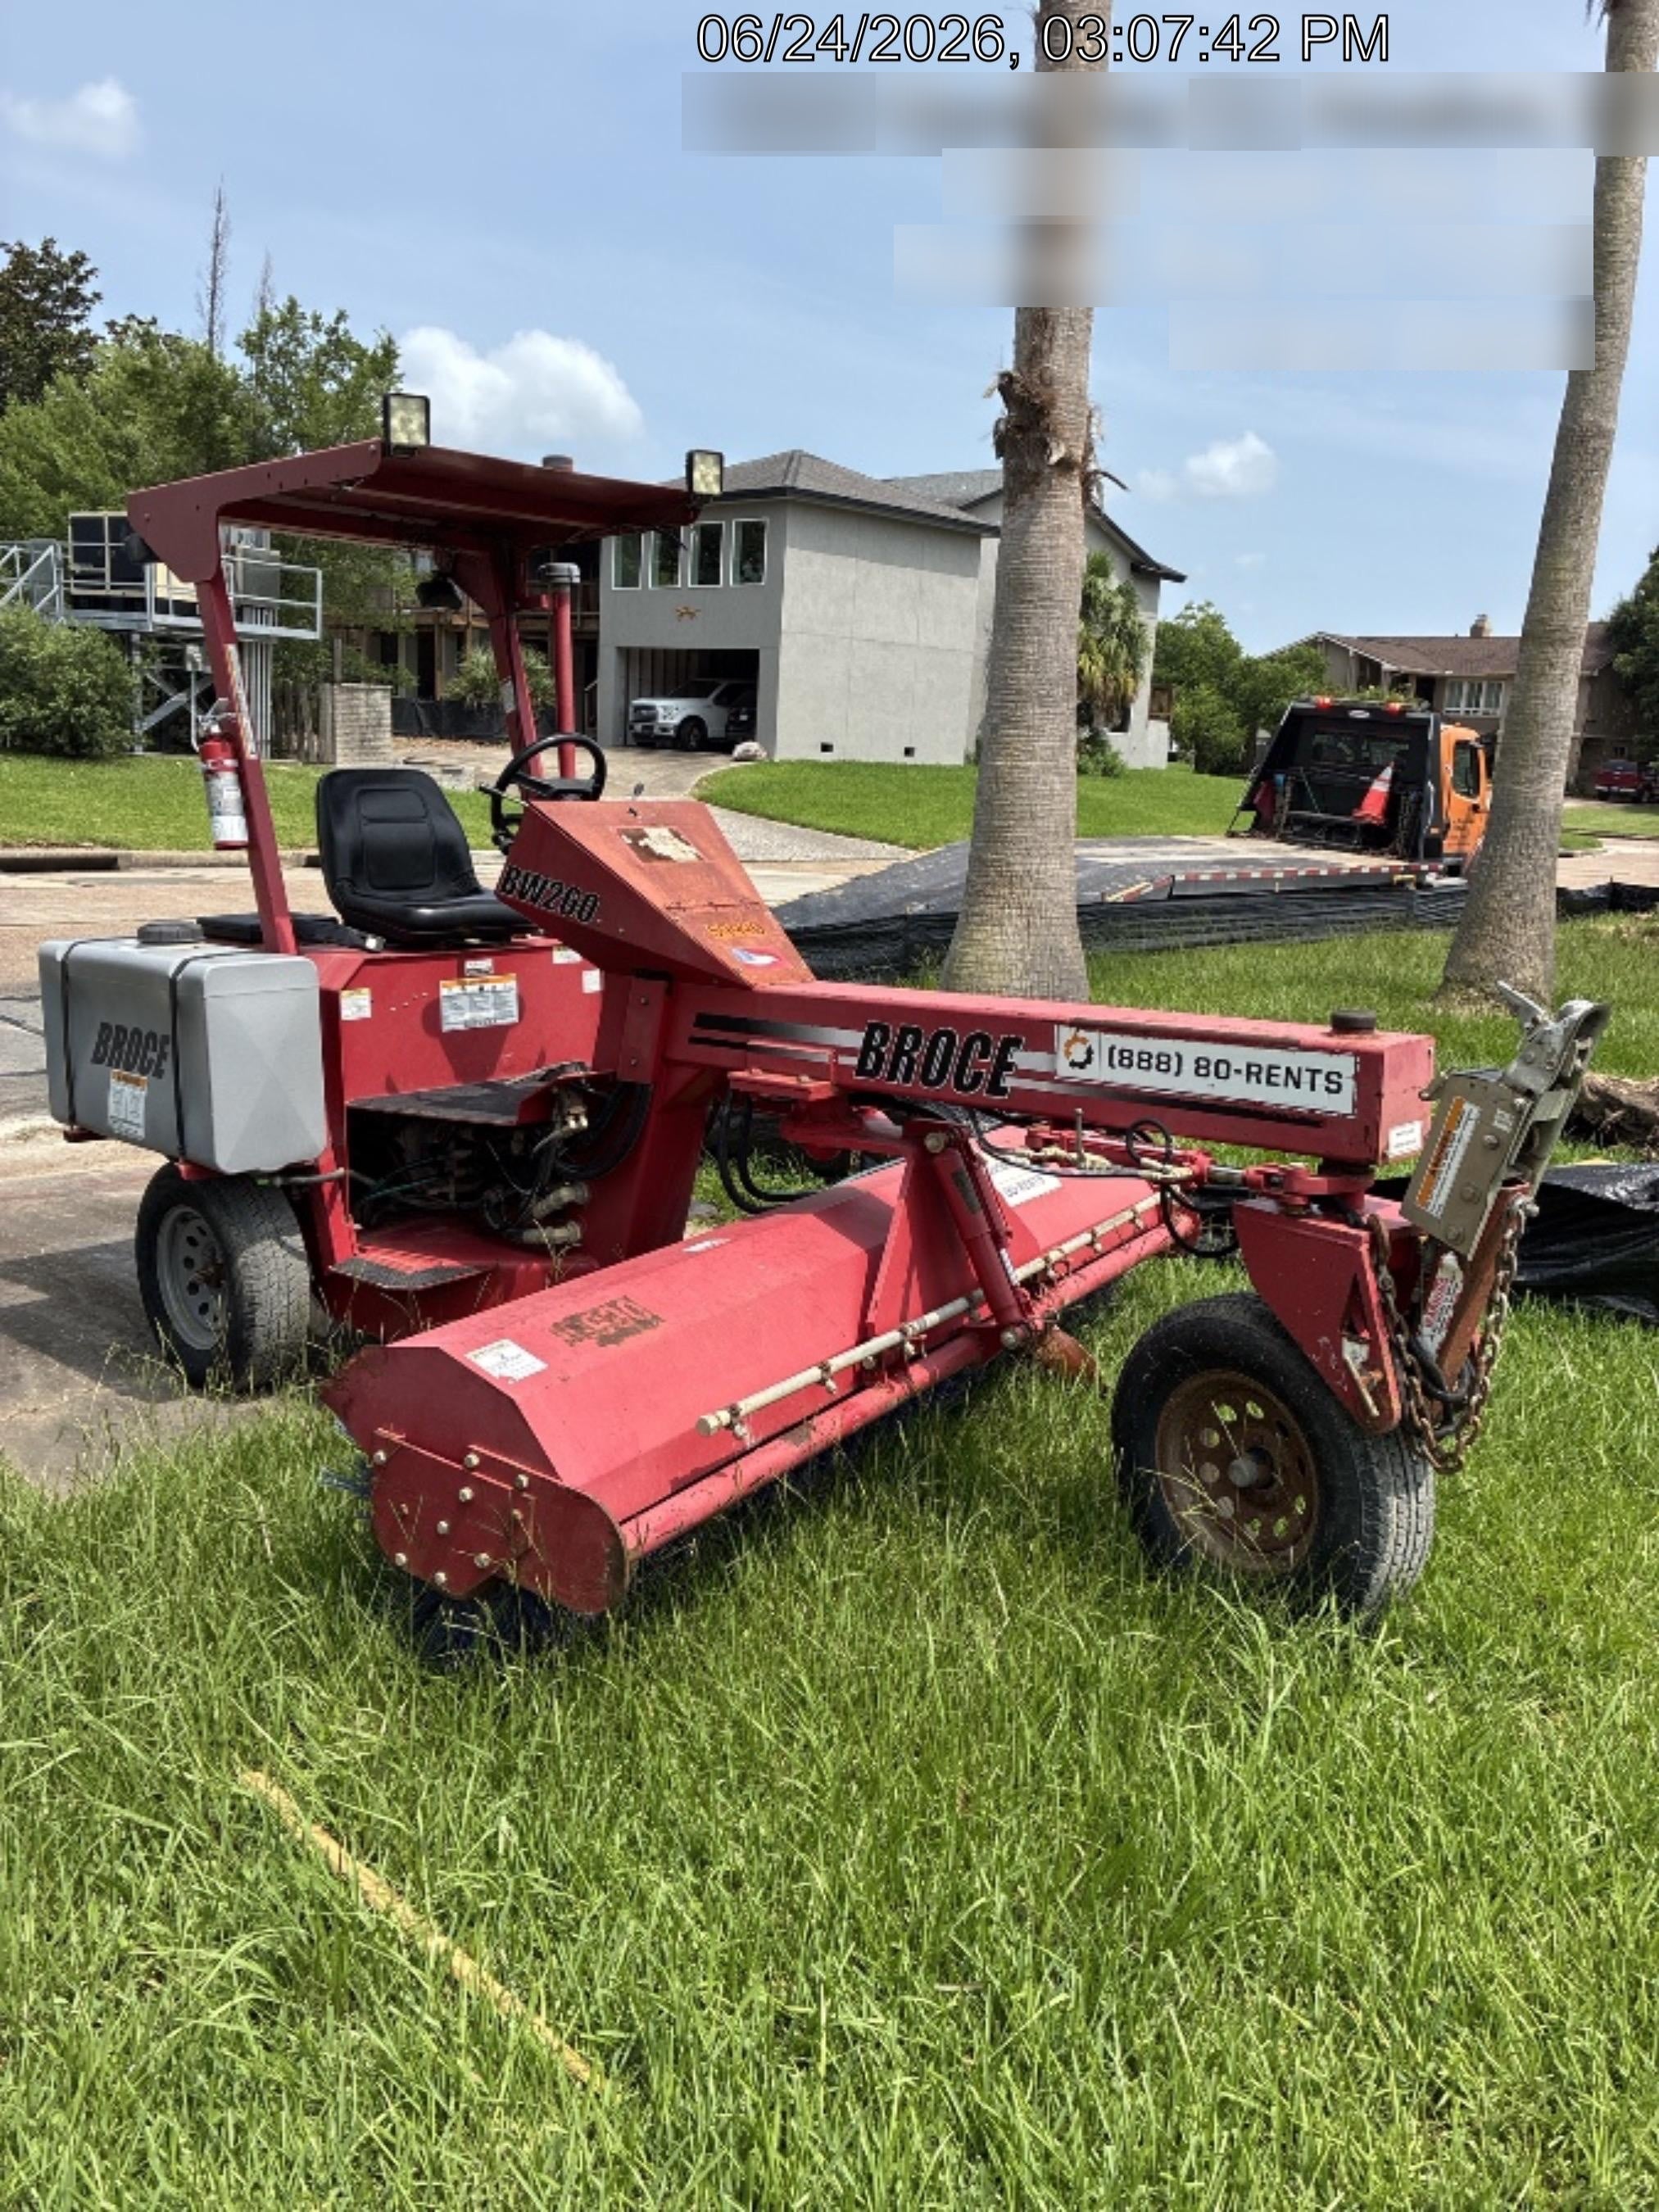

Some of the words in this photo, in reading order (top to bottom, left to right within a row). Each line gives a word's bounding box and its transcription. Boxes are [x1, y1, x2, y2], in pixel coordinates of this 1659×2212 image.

[500, 865, 600, 924] BW260
[90, 1022, 170, 1079] BROCE
[853, 1020, 1025, 1099] BROCE
[1108, 1044, 1183, 1077] (888)
[1193, 1055, 1344, 1095] 80-RENTS
